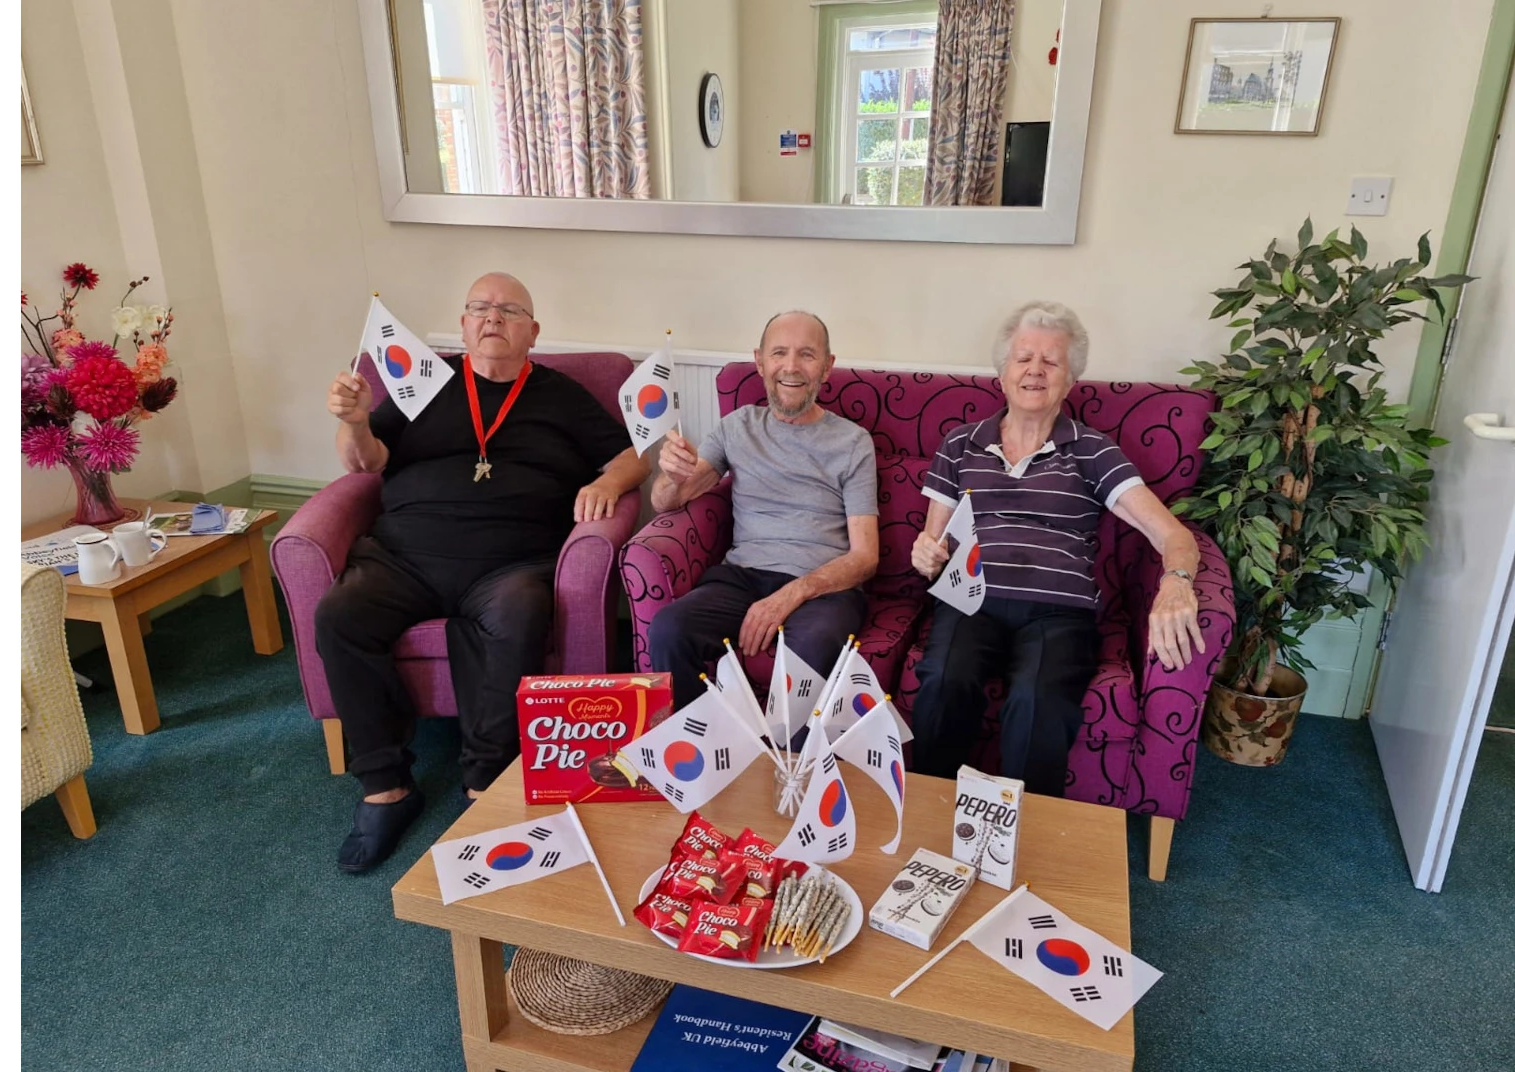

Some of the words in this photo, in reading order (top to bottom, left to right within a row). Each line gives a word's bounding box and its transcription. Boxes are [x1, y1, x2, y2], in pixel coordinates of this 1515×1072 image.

[529, 680, 584, 690] Choco
[586, 678, 616, 688] Pie
[576, 702, 614, 714] Happy
[527, 716, 627, 741] Choco
[530, 743, 586, 770] Pie
[955, 793, 1017, 828] PEPERO
[684, 836, 704, 851] Pie
[744, 844, 774, 863] Choc
[674, 868, 697, 880] Pie
[681, 859, 716, 874] Choco
[900, 861, 967, 891] PEPERO
[649, 900, 672, 913] Pie
[654, 893, 691, 912] Choco
[699, 911, 738, 927] Choco
[693, 922, 718, 935] Pie
[673, 1013, 732, 1032] Handbook
[681, 1031, 702, 1043] UK
[734, 1024, 793, 1042] Resident's
[703, 1034, 769, 1054] Abbeyfield
[802, 1033, 898, 1072] gazine
